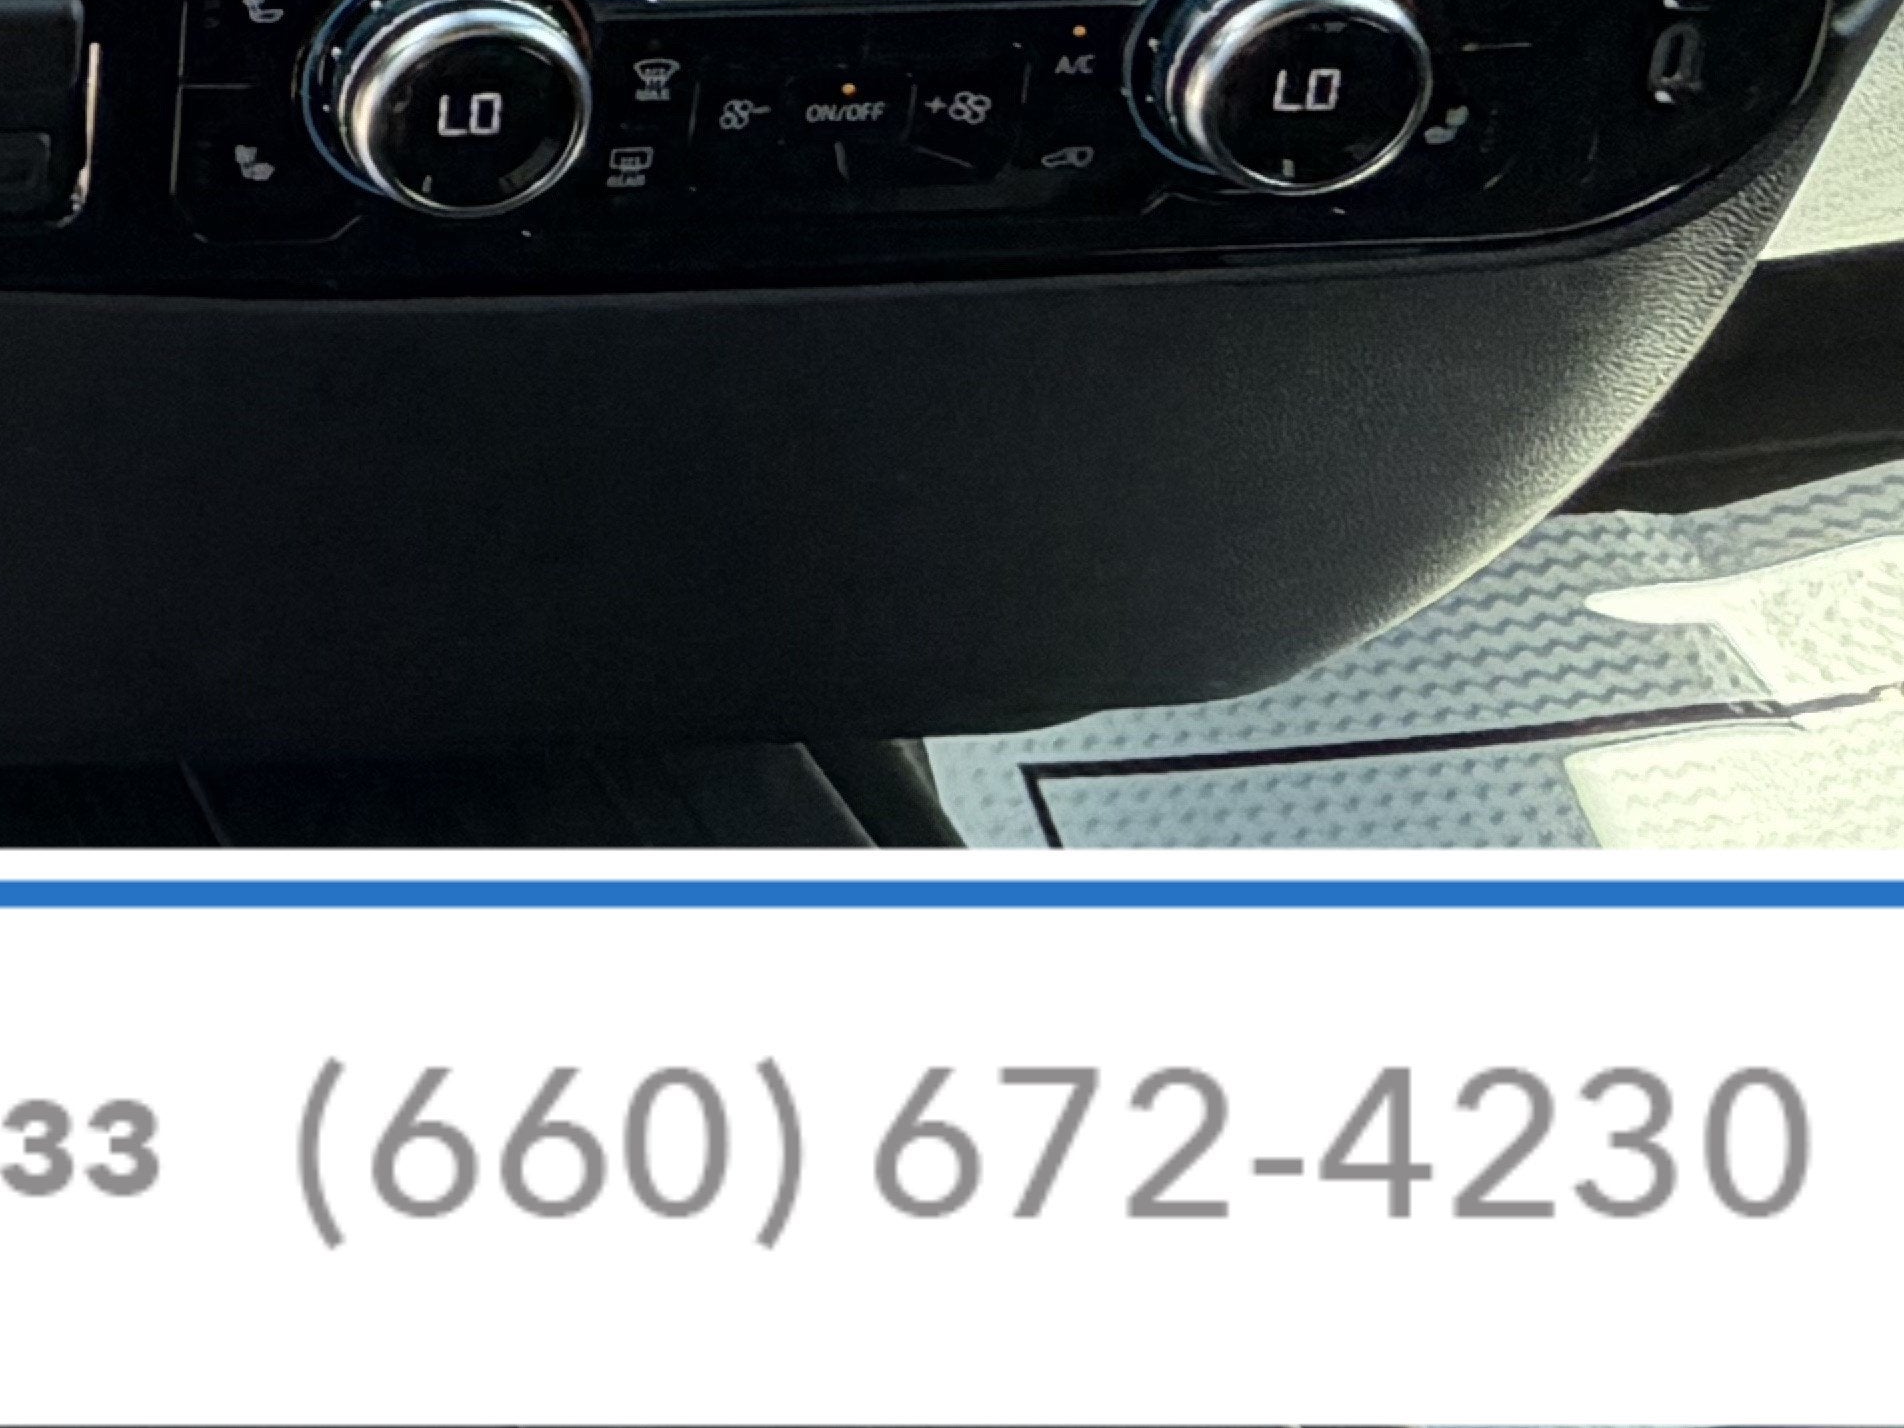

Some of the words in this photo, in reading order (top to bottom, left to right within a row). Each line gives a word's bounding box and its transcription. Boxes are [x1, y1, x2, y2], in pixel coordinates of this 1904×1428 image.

[1055, 55, 1093, 74] A/C
[1273, 69, 1341, 111] LO
[439, 93, 501, 135] LO
[806, 101, 885, 123] ON/OFF
